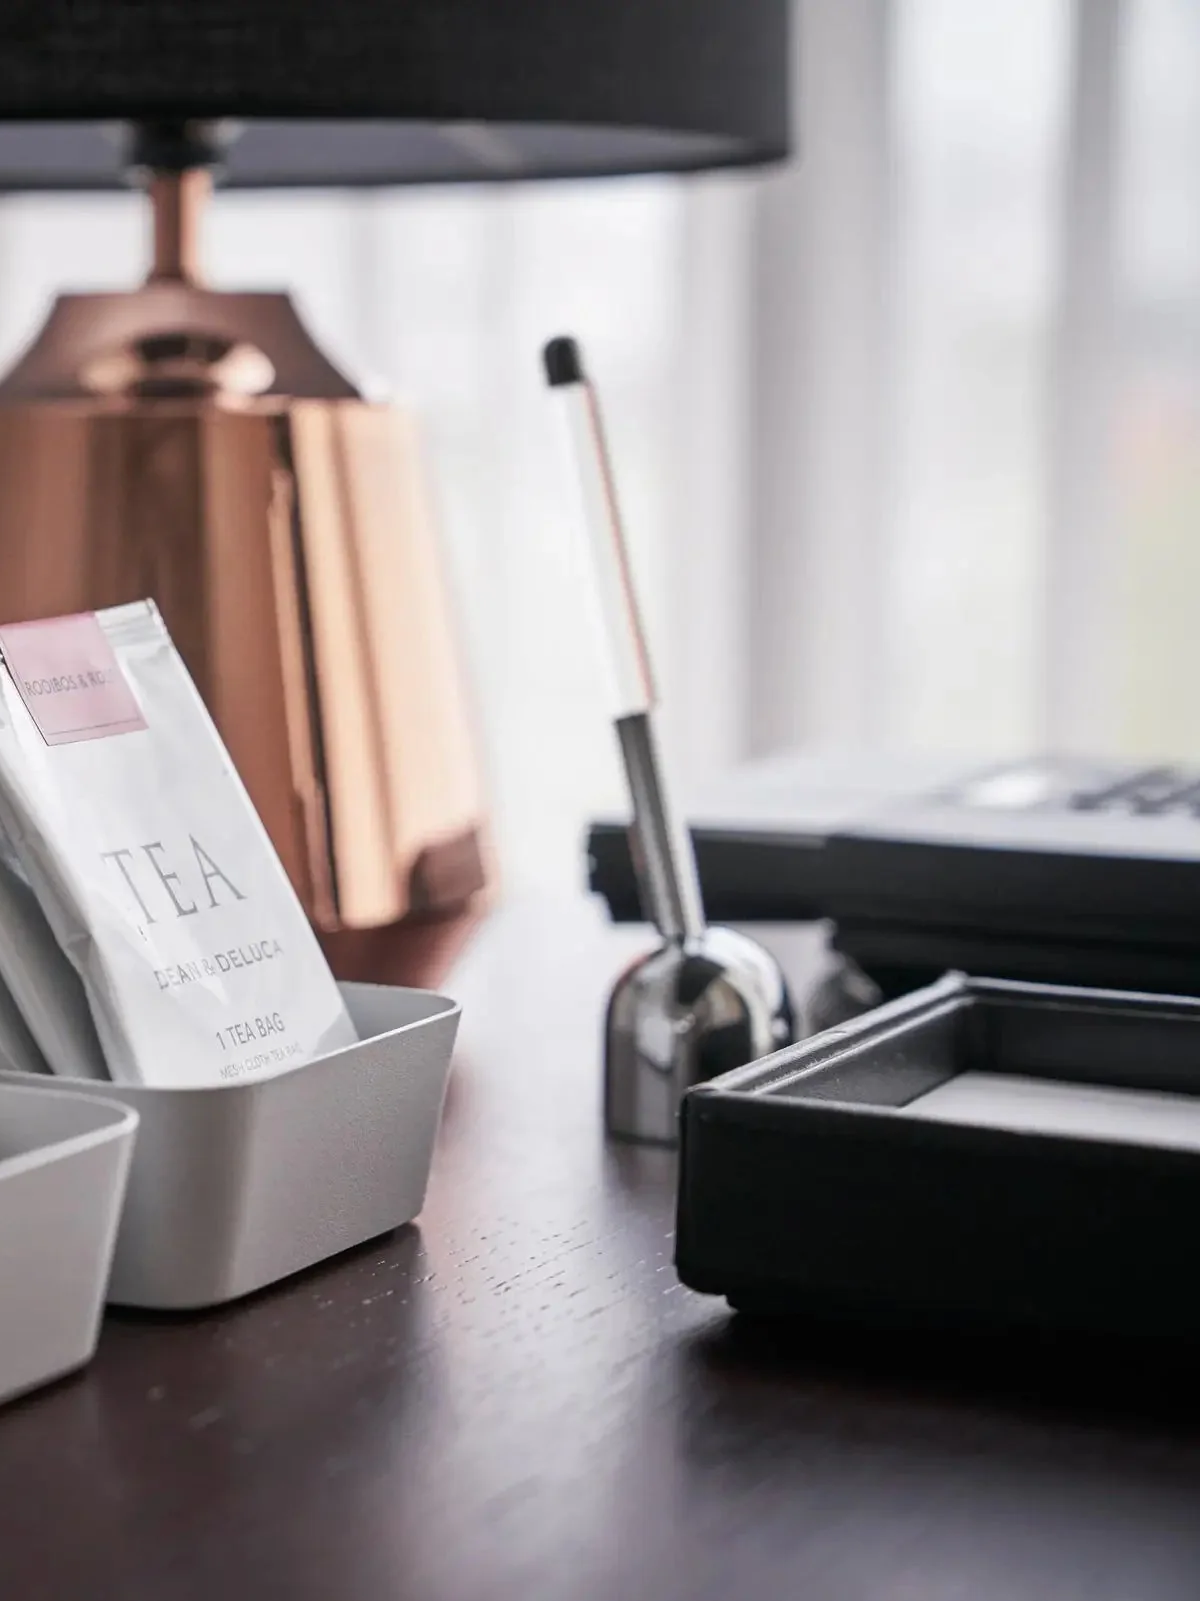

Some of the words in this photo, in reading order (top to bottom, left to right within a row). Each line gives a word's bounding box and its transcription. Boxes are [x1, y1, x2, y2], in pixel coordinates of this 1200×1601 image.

[24, 674, 78, 697] ROOIBOS
[99, 833, 248, 925] TEA
[153, 961, 202, 990] DEAN
[202, 957, 216, 977] &
[214, 938, 285, 973] DELUCA
[215, 1031, 227, 1051] 1
[225, 1021, 257, 1047] TEA
[255, 1012, 286, 1038] BAG
